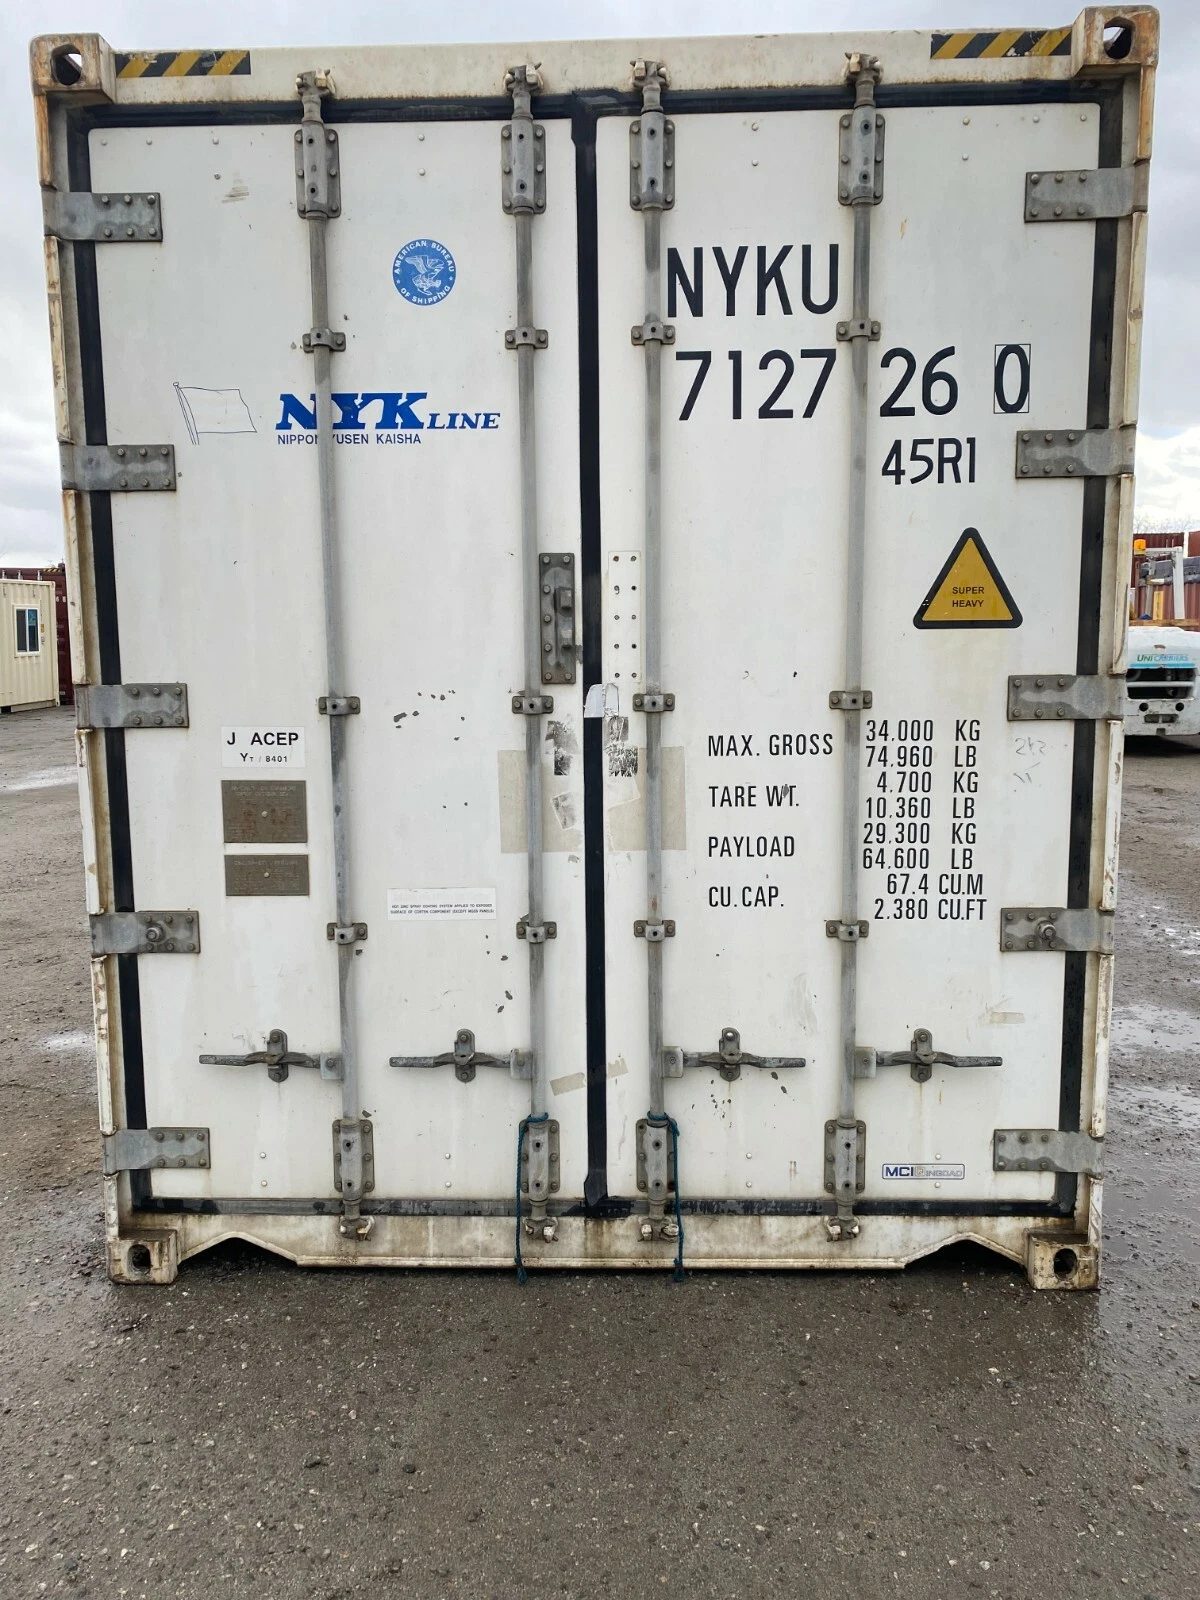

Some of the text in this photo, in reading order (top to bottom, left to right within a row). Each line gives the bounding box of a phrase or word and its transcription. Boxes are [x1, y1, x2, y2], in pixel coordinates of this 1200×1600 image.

[394, 241, 455, 275] AMERICAN BUREAU
[667, 243, 839, 318] NYKU
[401, 285, 451, 304] OF SHIPPING
[675, 343, 1031, 421] 7127 26 0
[275, 392, 501, 430] NYK LINE
[332, 433, 369, 445] USEN
[376, 432, 422, 444] KAISHA
[881, 437, 976, 485] 45R1
[952, 586, 985, 595] SUPER
[952, 599, 985, 608] HEAVY
[226, 731, 299, 746] J ACEP
[955, 719, 981, 742] KG
[708, 733, 834, 757] MAX. GROSS
[954, 745, 977, 768] LB
[265, 755, 288, 763] 8401
[953, 771, 979, 794] KG
[708, 785, 800, 808] TARE WT.
[952, 797, 975, 820] LB
[951, 822, 977, 845] KG
[708, 835, 796, 858] PAYLOAD
[951, 848, 974, 870] LB
[887, 873, 984, 896] 67.4 CU.M
[708, 885, 785, 908] CU.CAP.
[938, 898, 988, 921] CU.FT
[885, 1166, 914, 1177] MCI
